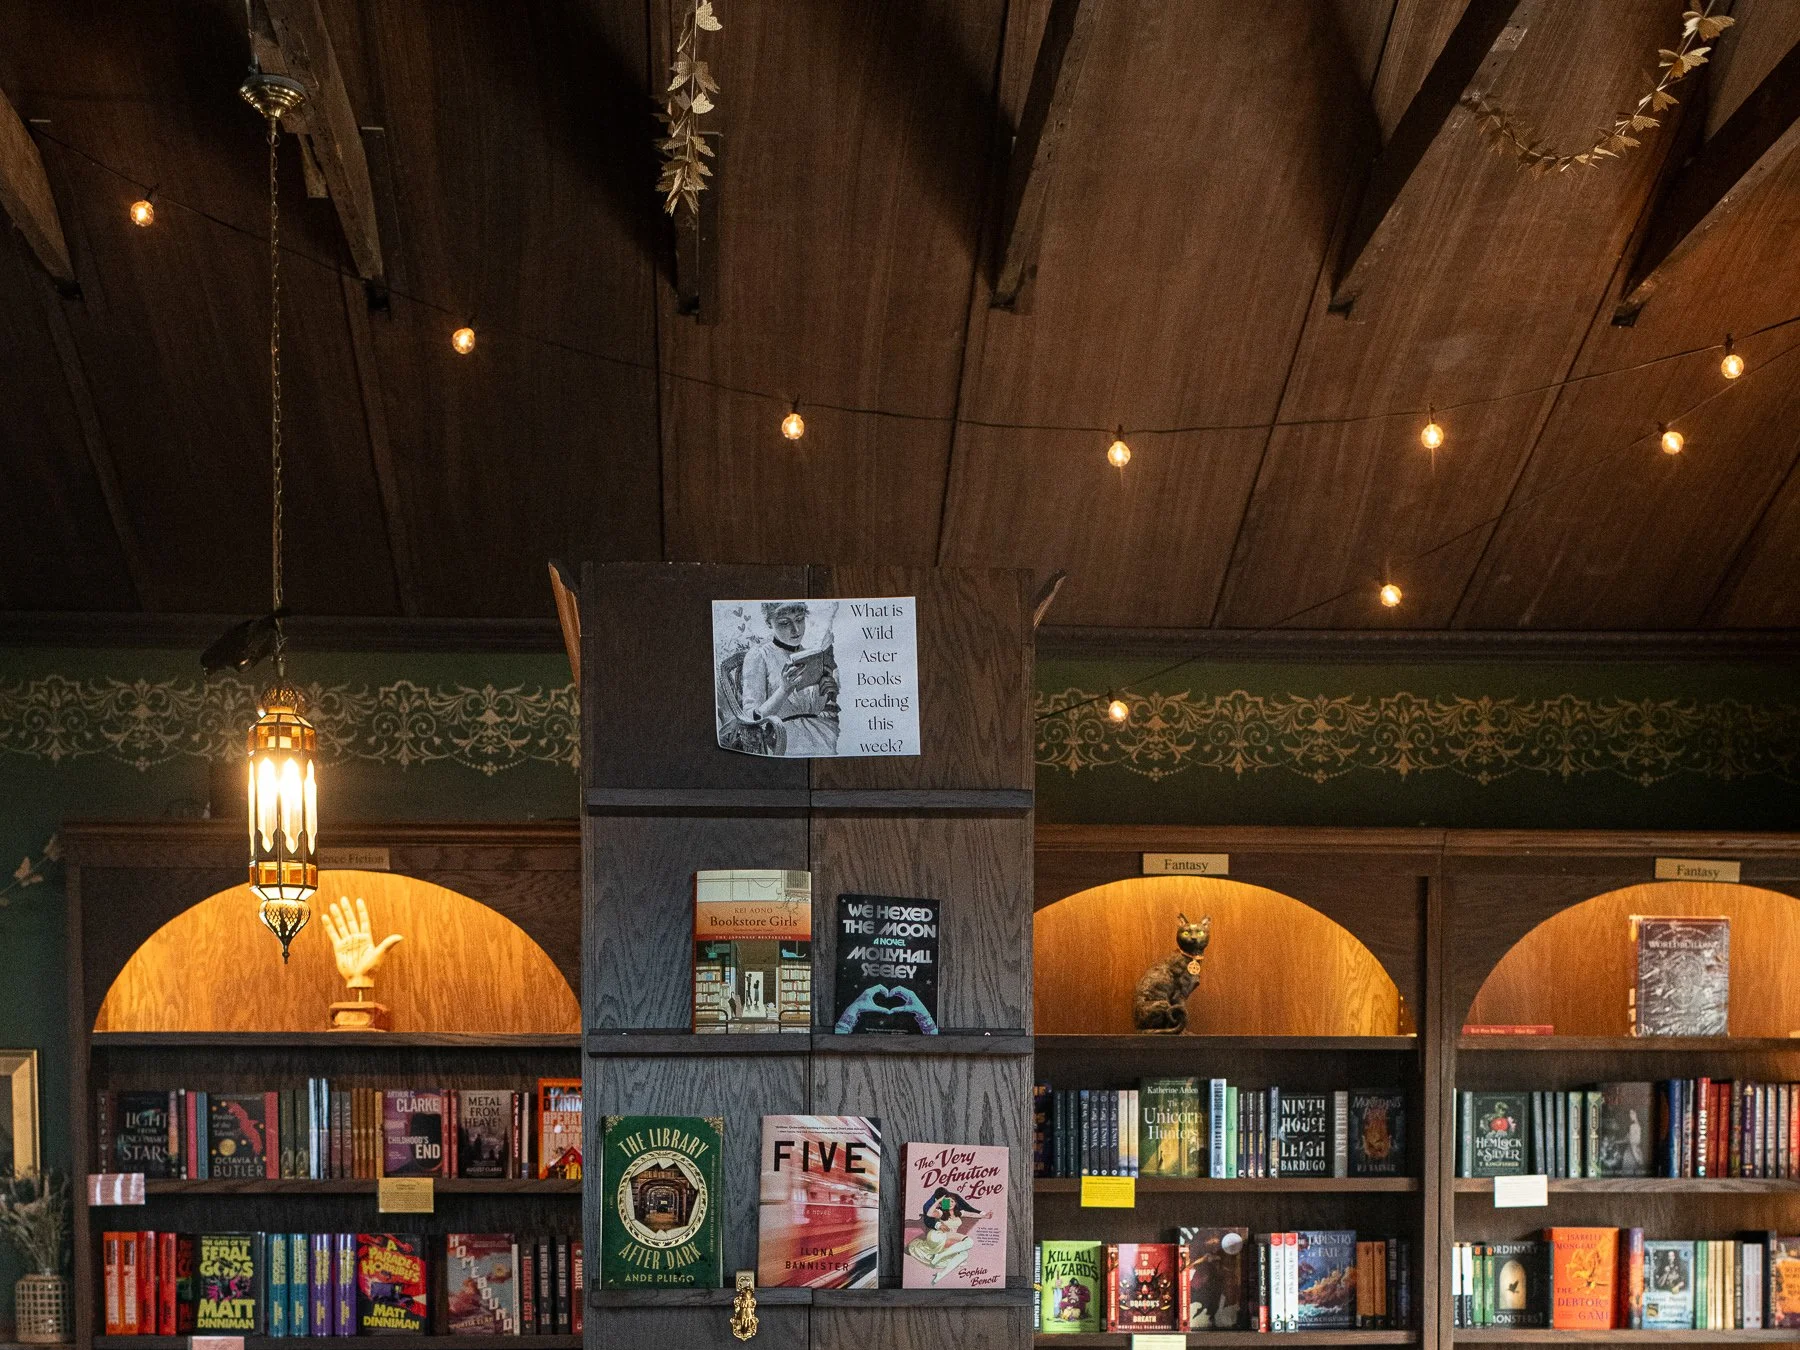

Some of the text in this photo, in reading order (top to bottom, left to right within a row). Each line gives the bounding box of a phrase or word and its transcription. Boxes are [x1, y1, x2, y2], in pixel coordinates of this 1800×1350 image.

[851, 604, 903, 617] What is
[861, 625, 894, 640] Wild
[859, 650, 898, 663] Aster
[857, 671, 902, 685] Books
[855, 694, 910, 711] reading
[868, 716, 894, 730] this
[860, 739, 903, 753] week?
[1164, 858, 1209, 873] Fantasy
[1676, 864, 1720, 879] Fantasy
[847, 904, 934, 921] WE HEXED
[710, 916, 798, 927] Bookstore Girls
[842, 919, 936, 938] THE MOON
[880, 938, 906, 947] NOVEL
[860, 962, 918, 979] SEELEY
[1146, 1086, 1179, 1094] Katherine
[396, 1098, 442, 1113] CLARKE
[467, 1096, 502, 1107] METAL
[1281, 1099, 1326, 1116] NINTH
[469, 1107, 501, 1117] FROM
[1143, 1107, 1203, 1124] Unicorn
[1147, 1125, 1199, 1140] Hunters
[415, 1143, 441, 1159] END
[617, 1128, 710, 1159] THE LIBRARY
[772, 1140, 868, 1174] FIVE
[914, 1147, 976, 1170] The Very
[213, 1166, 264, 1178] BUTLER
[1280, 1160, 1326, 1171] BARDUGO
[920, 1165, 1002, 1189] Definition
[956, 1181, 1004, 1200] of Love
[201, 1246, 252, 1261] FERAL
[367, 1246, 412, 1266] PARADE
[618, 1242, 703, 1271] AFTER DARK
[800, 1247, 835, 1257] ILONA
[1047, 1248, 1097, 1264] KILL ALL
[199, 1261, 254, 1278] GODS
[785, 1260, 850, 1272] BANNISTER
[957, 1266, 988, 1279] Sophia
[574, 1258, 584, 1290] PARASITE
[624, 1272, 695, 1283] ANDE PLIEGO
[970, 1275, 1001, 1287] Benoit
[197, 1299, 256, 1319] MATT
[372, 1303, 406, 1319] MATT
[197, 1318, 255, 1329] DINNIMAN
[362, 1315, 420, 1330] DINNIMAN
[1132, 1315, 1157, 1323] BREATH
